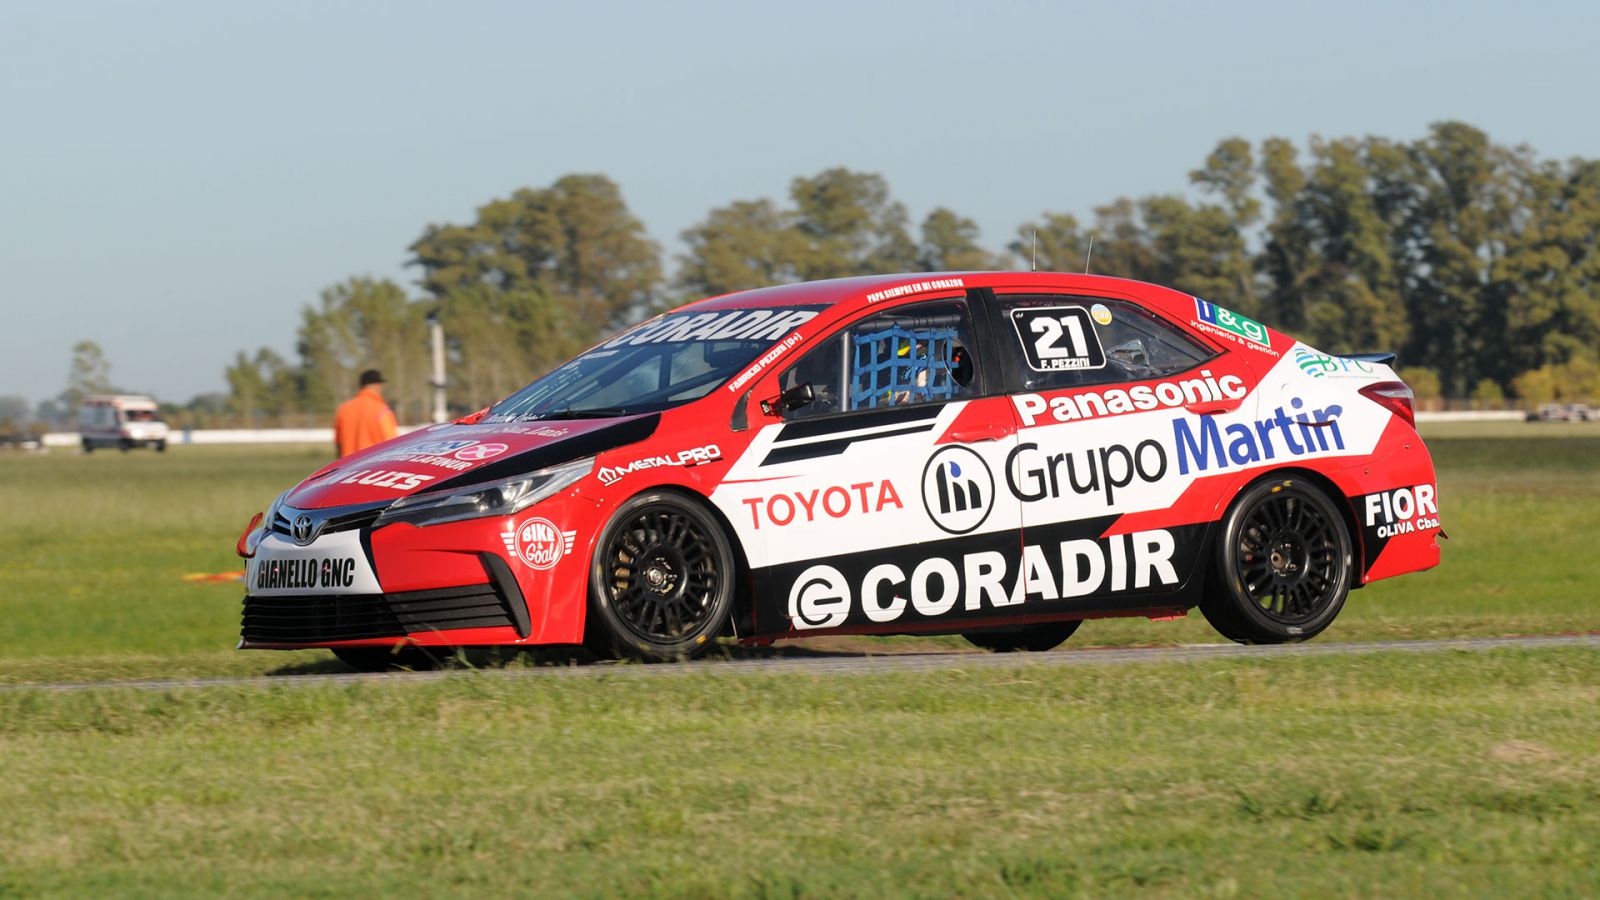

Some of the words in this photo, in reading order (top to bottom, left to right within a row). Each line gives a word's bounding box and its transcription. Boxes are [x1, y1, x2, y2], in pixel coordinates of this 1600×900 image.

[866, 291, 886, 303] PAPA
[884, 285, 913, 298] SIEMPRE
[912, 282, 922, 292] EN
[921, 281, 932, 290] MI
[931, 278, 964, 289] CORAZON
[604, 310, 820, 350] CORADIR
[1030, 315, 1089, 359] 21
[1237, 337, 1245, 345] &
[728, 363, 762, 392] FABRICIO
[758, 343, 788, 368] PEZZINI
[1041, 359, 1051, 369] F.
[1051, 357, 1090, 369] PEZZINI
[1011, 370, 1247, 428] Panasonic
[410, 455, 474, 471] LAFINUR
[616, 443, 722, 475] METALPRO
[1005, 438, 1168, 507] Grupo
[1172, 396, 1346, 476] Martin
[339, 469, 437, 490] LUIS
[743, 479, 904, 530] TOYOTA
[1365, 483, 1438, 527] FIOR
[522, 523, 555, 543] BIKE
[1377, 520, 1415, 538] OLIVA
[257, 559, 318, 589] GIANELLO
[320, 557, 356, 588] GNC
[860, 528, 1179, 623] CORADIR
